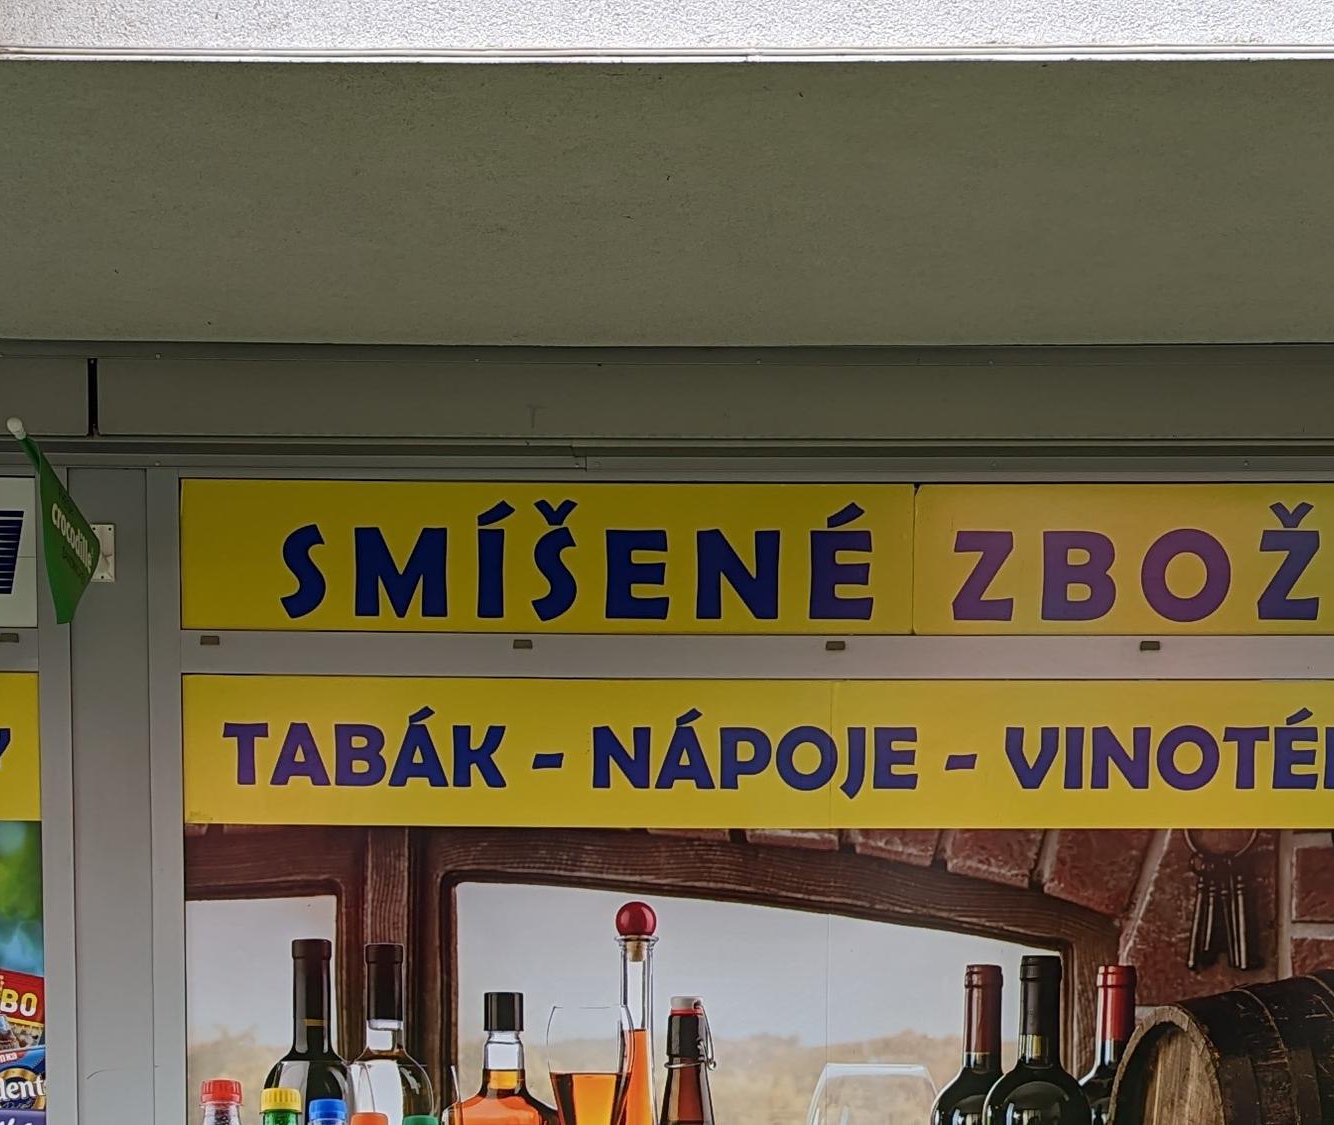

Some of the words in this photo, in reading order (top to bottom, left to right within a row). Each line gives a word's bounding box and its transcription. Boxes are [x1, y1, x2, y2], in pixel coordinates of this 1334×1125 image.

[280, 499, 874, 622] SMÍŠENÉ
[222, 705, 507, 789] TABÁK
[591, 708, 919, 801] NÁPOJE
